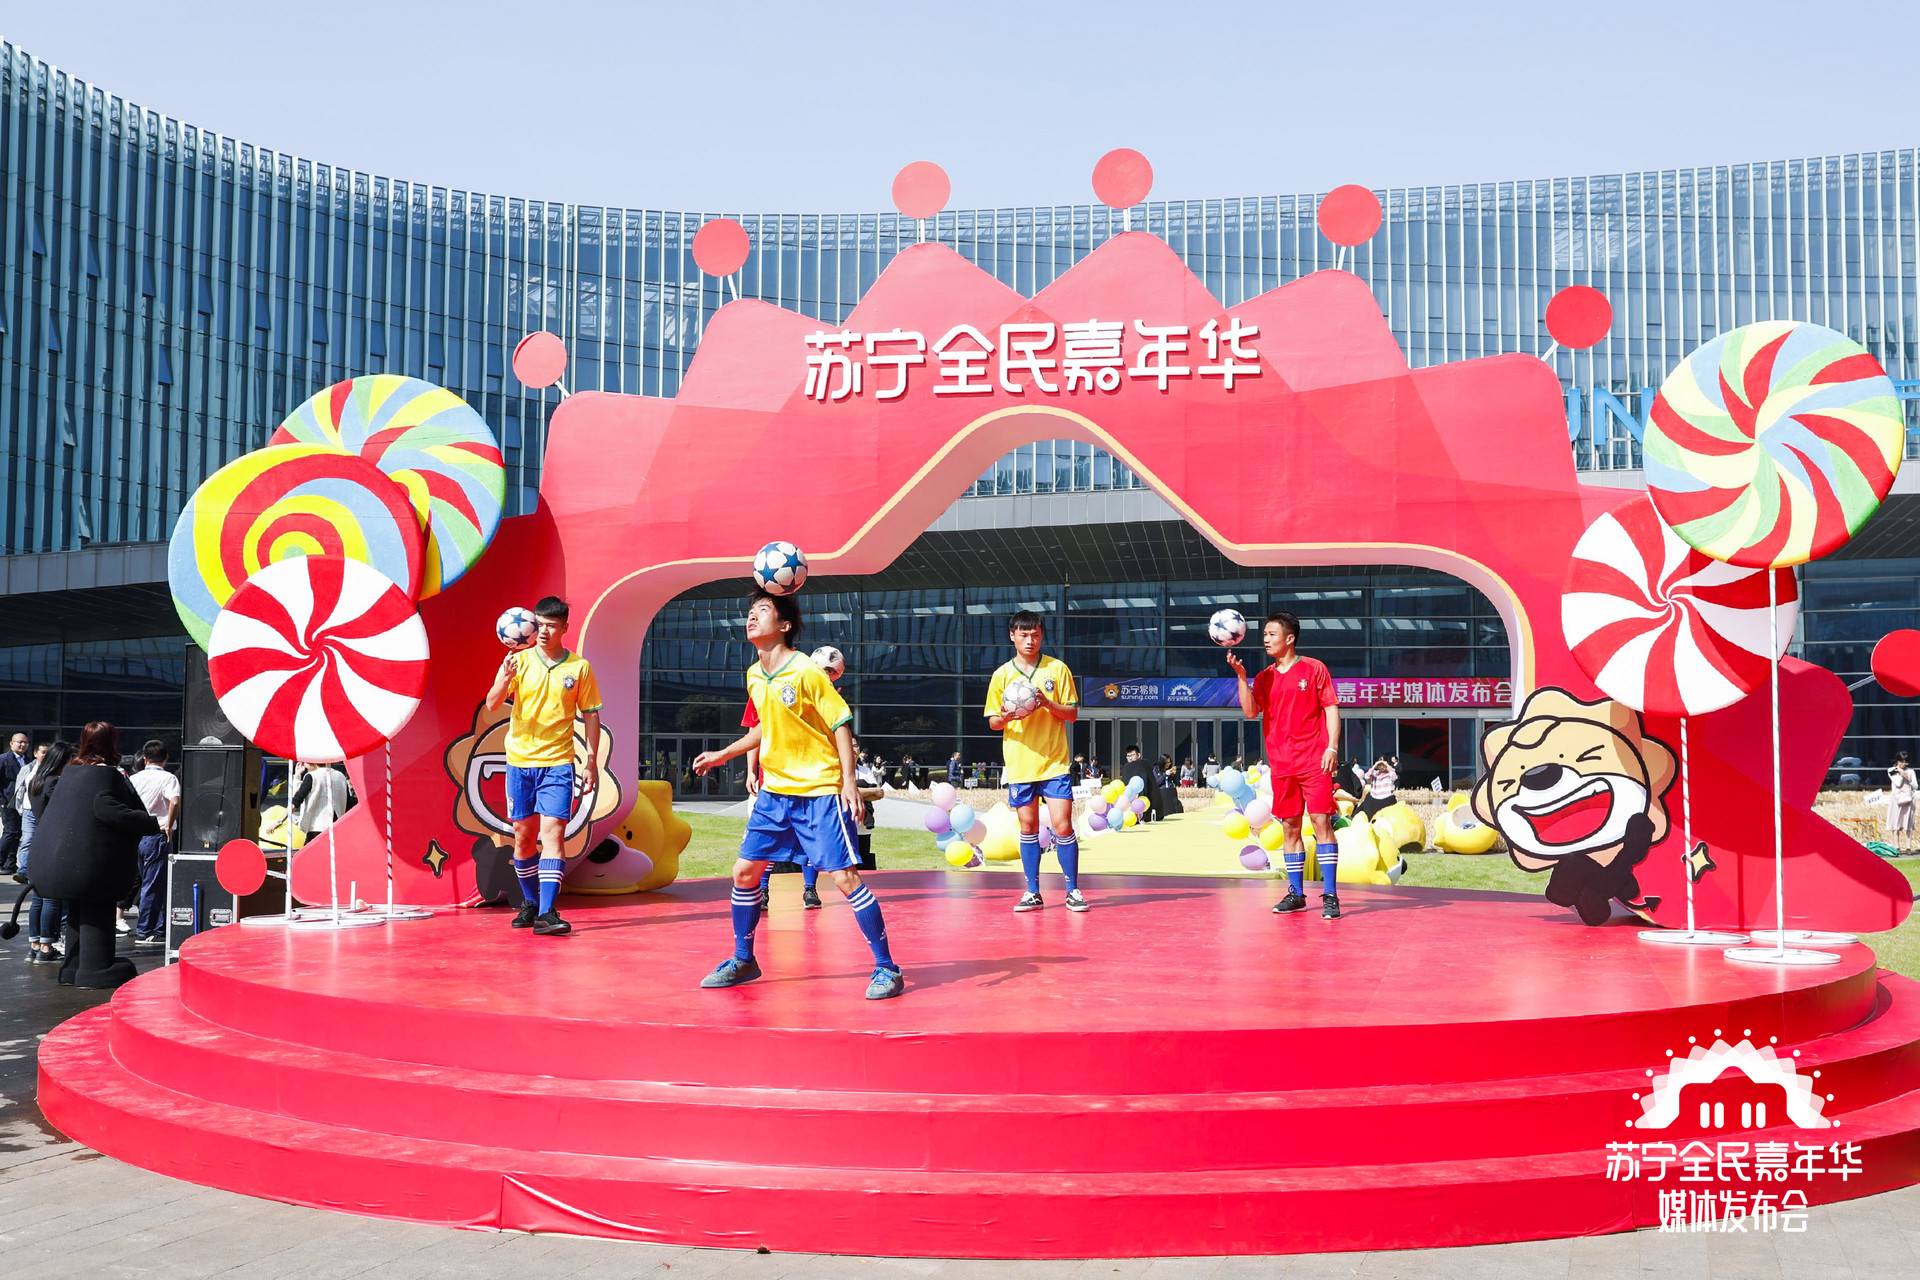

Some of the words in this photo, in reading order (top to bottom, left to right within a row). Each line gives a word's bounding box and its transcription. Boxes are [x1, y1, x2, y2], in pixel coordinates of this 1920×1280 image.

[804, 318, 1262, 401] 苏宁全民嘉年华
[1121, 685, 1158, 694] 苏宁易购
[1336, 681, 1512, 703] 嘉年华媒体发布会
[1121, 694, 1158, 702] suning.com
